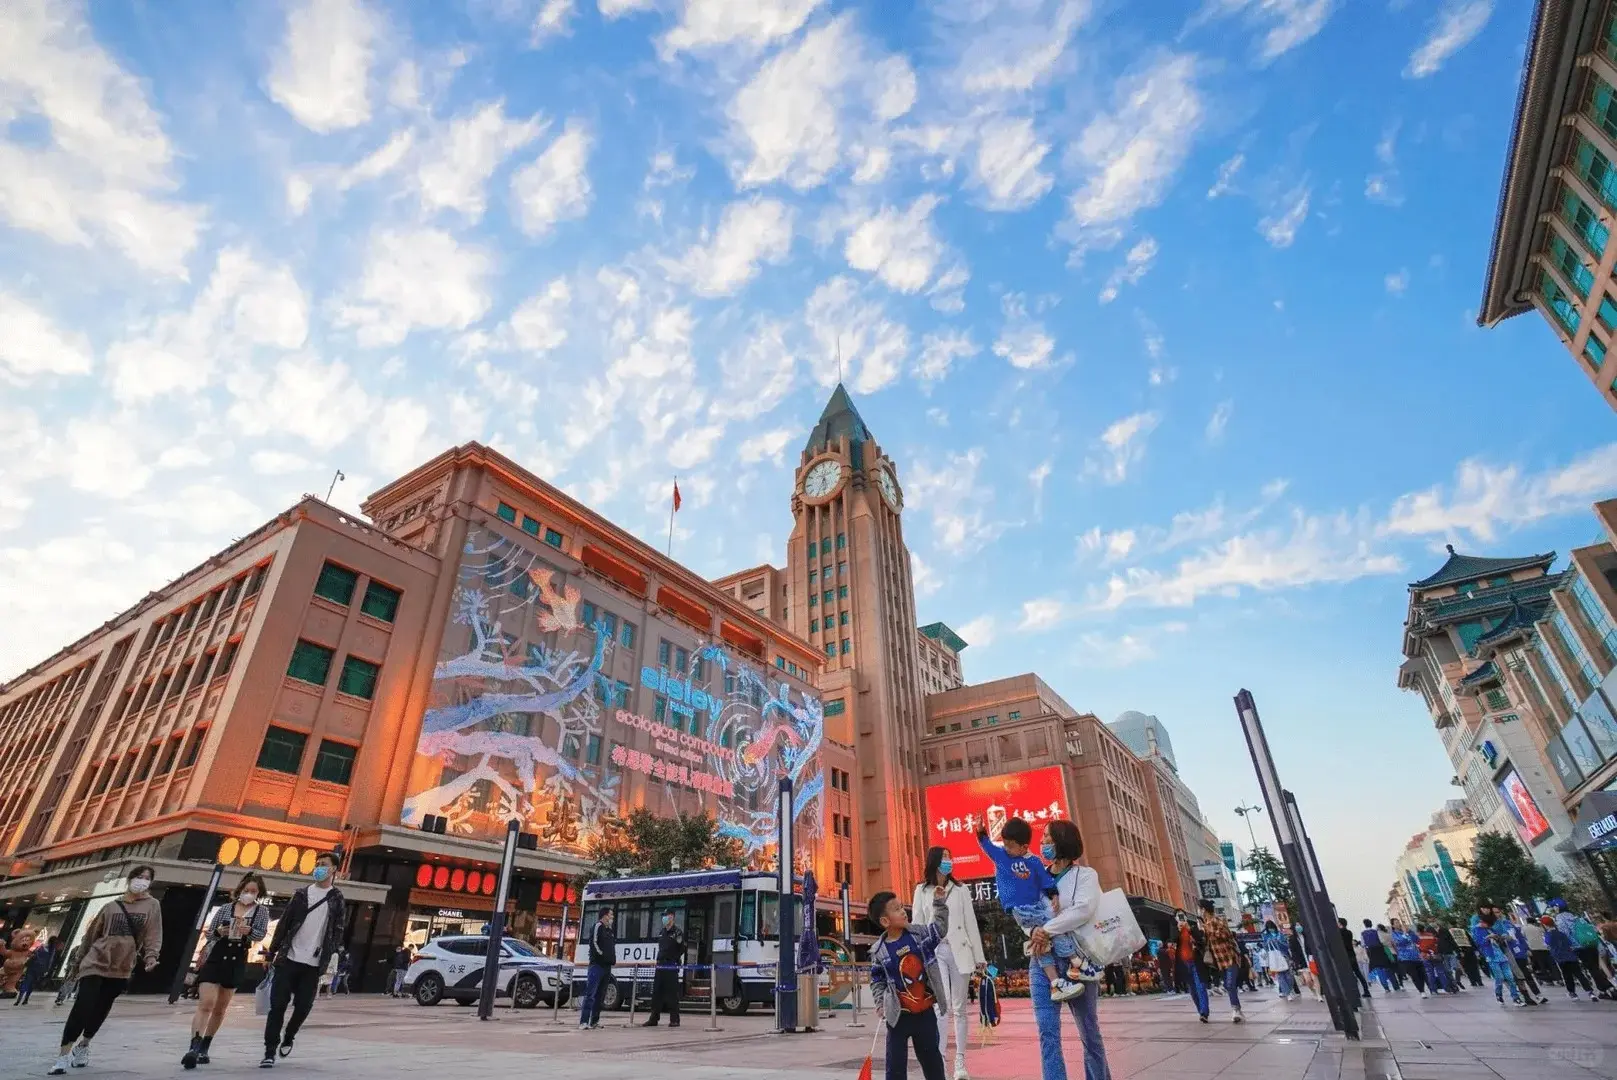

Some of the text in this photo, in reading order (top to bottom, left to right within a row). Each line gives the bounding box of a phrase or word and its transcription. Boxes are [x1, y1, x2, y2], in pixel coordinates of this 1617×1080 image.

[641, 666, 723, 720] sisley
[615, 709, 736, 761] ecological compound
[936, 813, 985, 837] 中国茅
[438, 909, 464, 918] CHANEL
[623, 947, 656, 960] POLI
[448, 964, 466, 973] 公安
